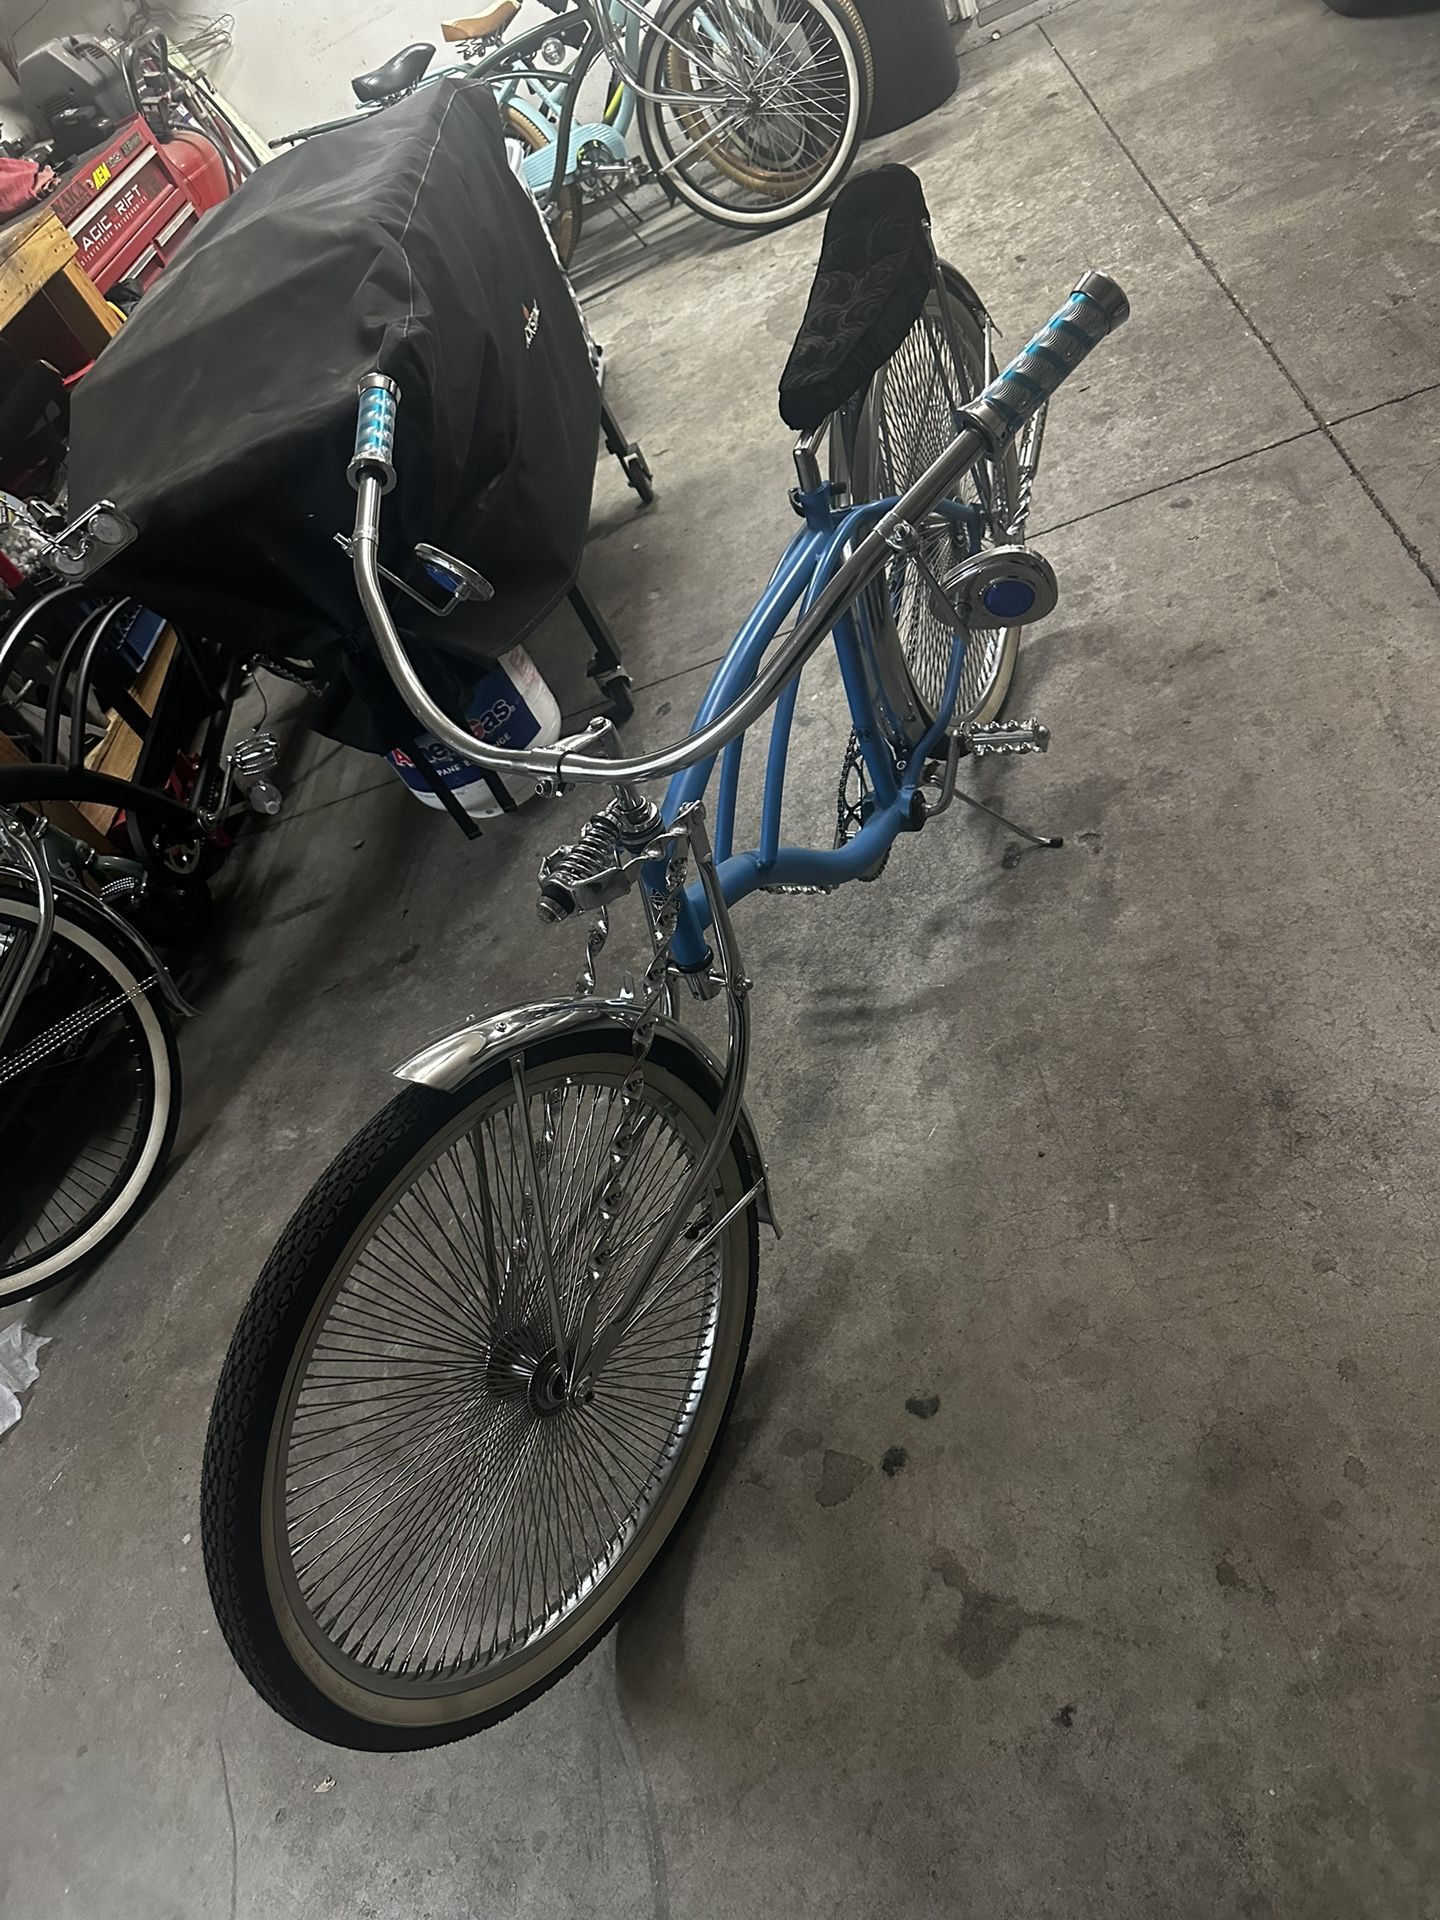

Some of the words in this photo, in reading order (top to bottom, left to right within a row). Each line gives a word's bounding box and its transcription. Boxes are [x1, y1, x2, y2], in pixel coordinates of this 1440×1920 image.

[91, 162, 112, 190] AEM
[82, 215, 113, 251] AGIC
[112, 184, 142, 220] RIFT
